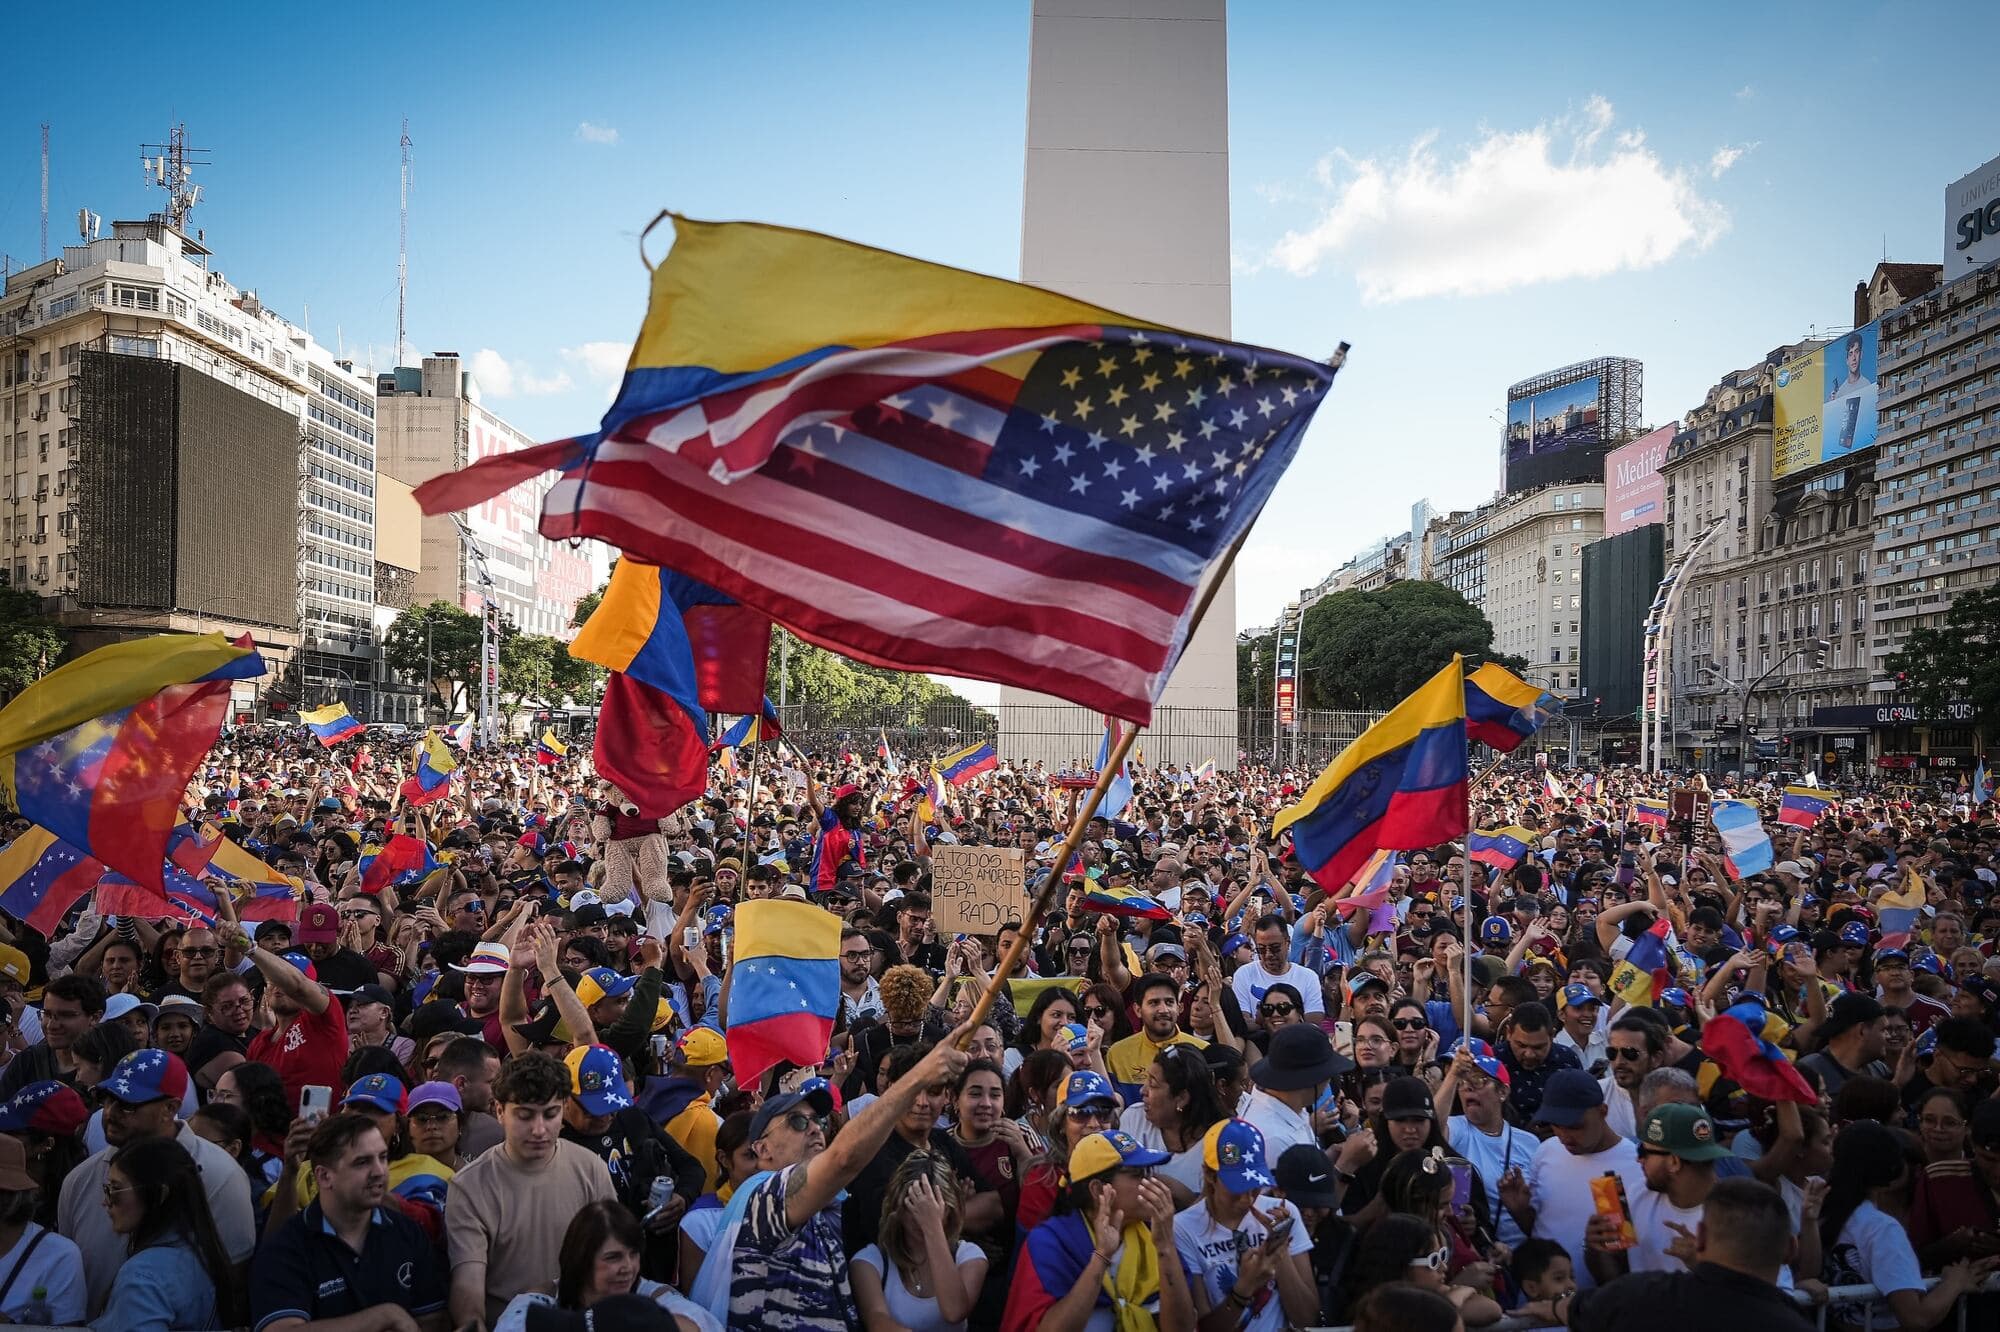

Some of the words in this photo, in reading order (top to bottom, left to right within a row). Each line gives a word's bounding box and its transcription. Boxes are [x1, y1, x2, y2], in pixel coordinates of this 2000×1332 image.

[1811, 422, 1819, 434] de
[1616, 444, 1662, 490] Medifé
[934, 849, 945, 865] A
[948, 849, 1002, 868] TODOS
[934, 865, 973, 880] ESOS
[977, 868, 1021, 886] AMORES
[934, 881, 977, 899] SEPA
[958, 900, 1022, 926] RADOS
